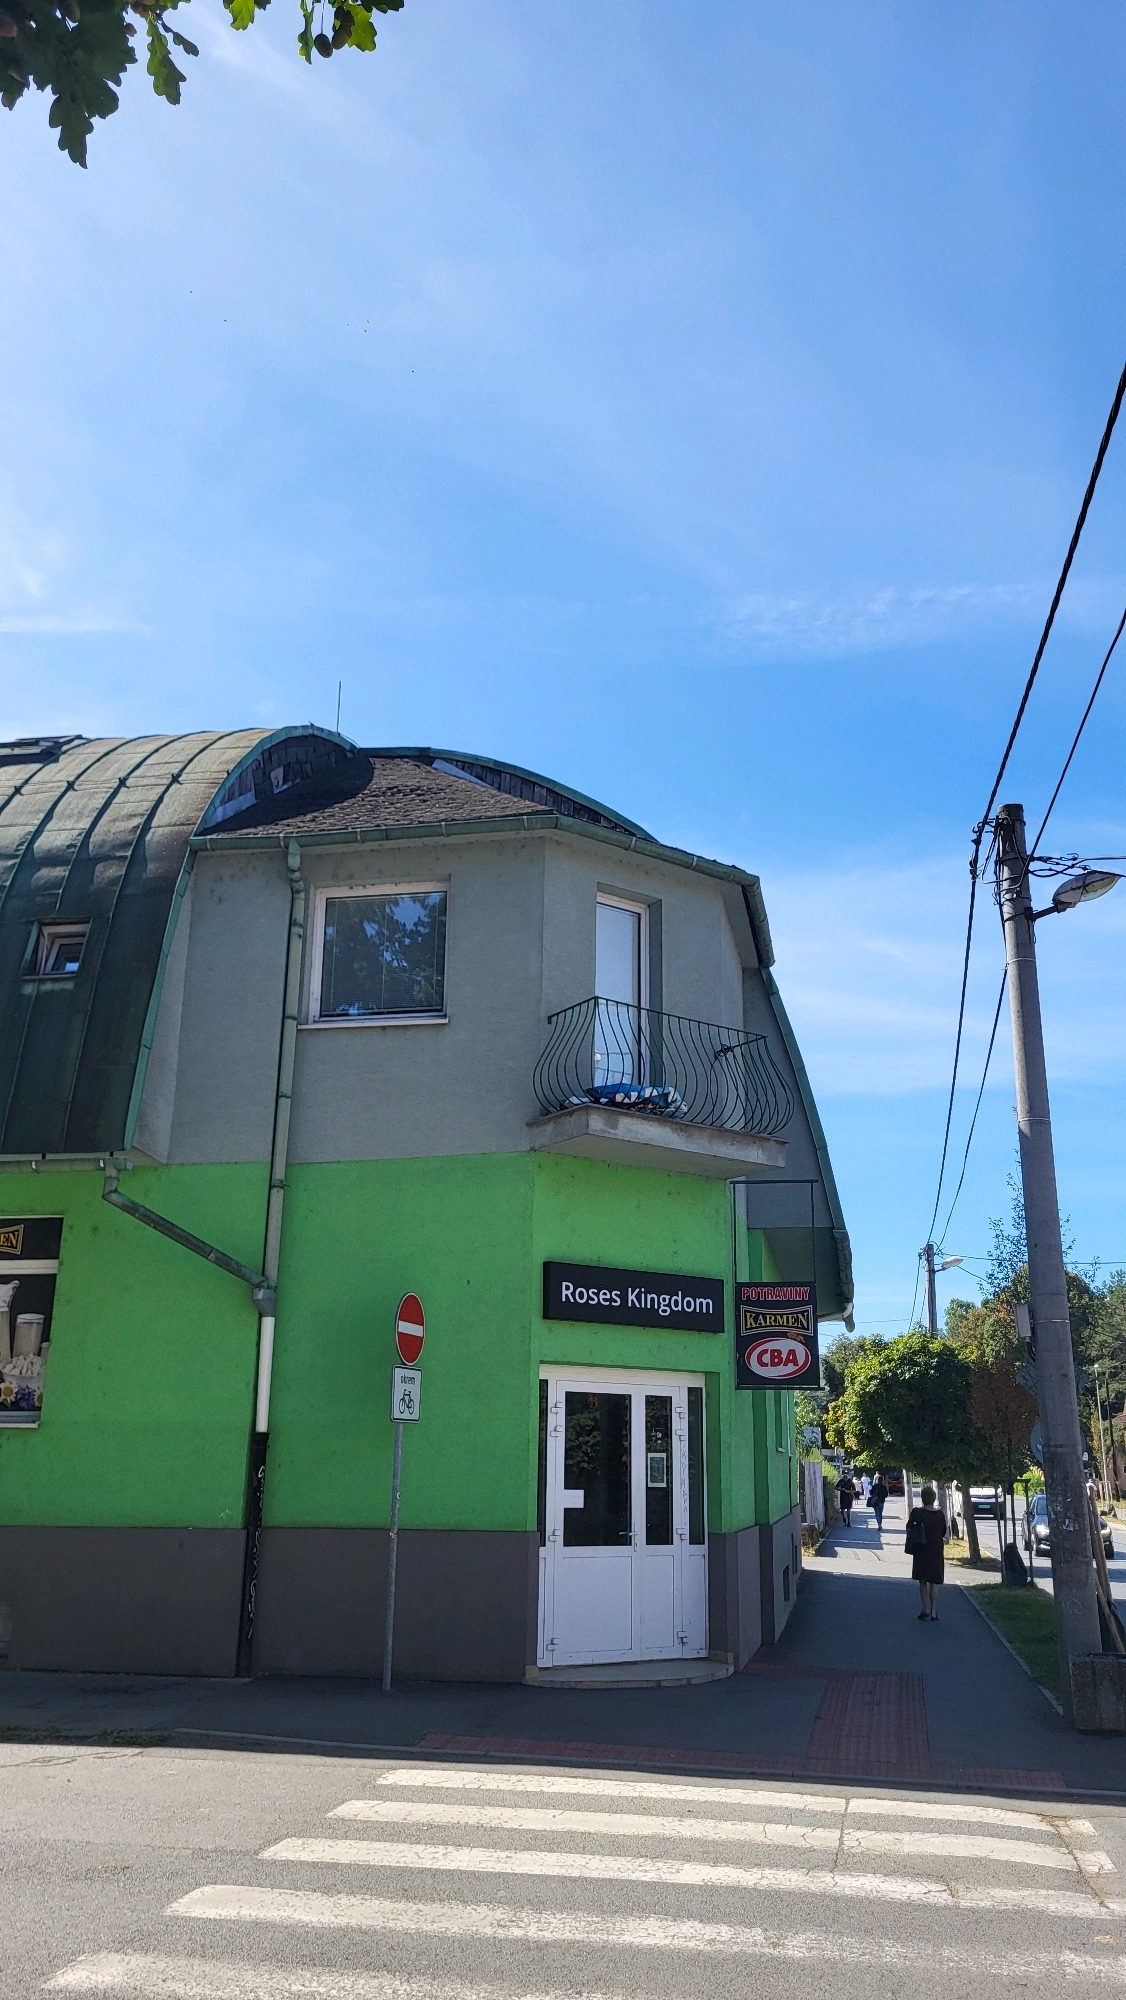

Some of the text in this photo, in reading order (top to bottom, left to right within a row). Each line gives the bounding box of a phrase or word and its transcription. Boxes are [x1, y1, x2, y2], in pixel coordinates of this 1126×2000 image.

[561, 1281, 714, 1316] Roses Kingdom
[741, 1286, 811, 1301] POTRAVINY
[745, 1311, 808, 1329] KARMEN
[756, 1348, 800, 1368] CBA
